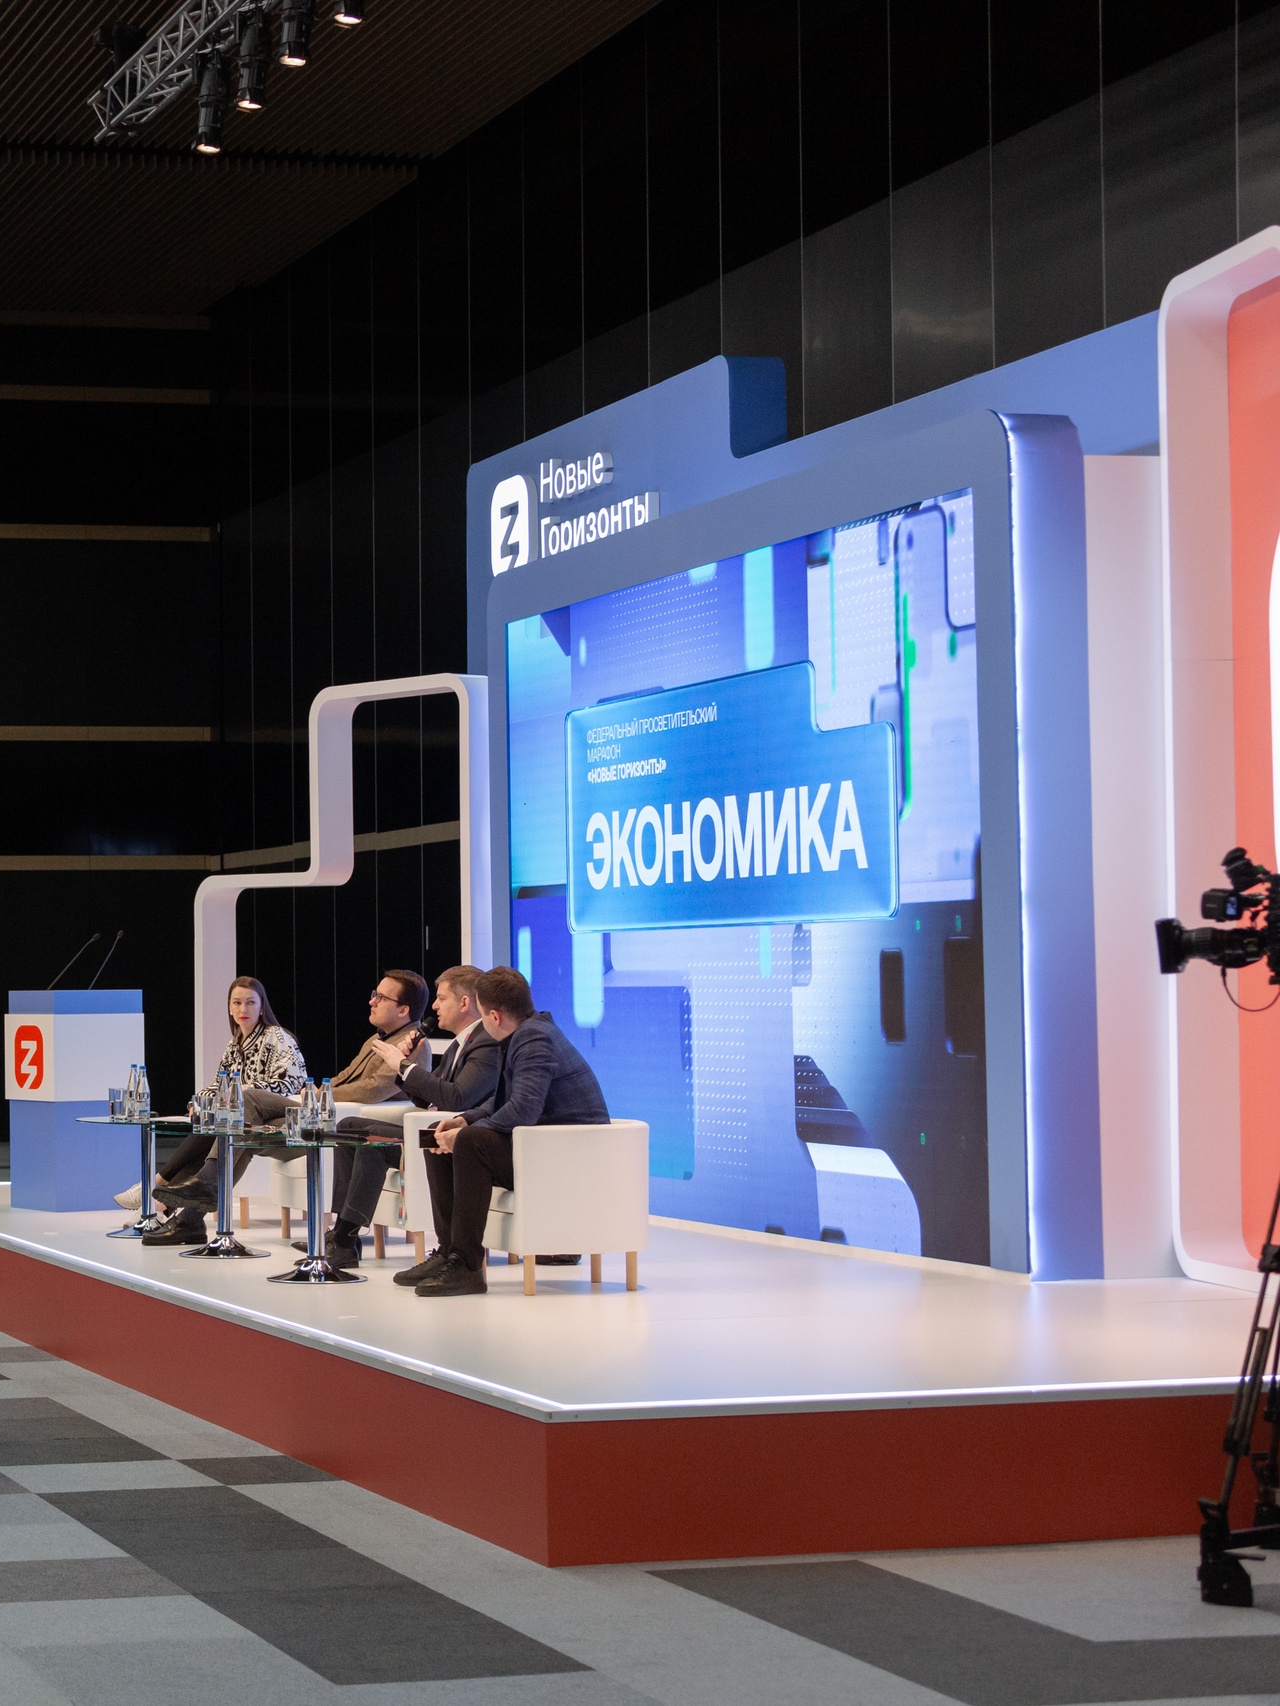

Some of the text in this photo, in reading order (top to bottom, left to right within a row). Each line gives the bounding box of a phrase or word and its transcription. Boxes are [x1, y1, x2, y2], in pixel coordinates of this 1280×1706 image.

[540, 452, 604, 503] Новые
[540, 491, 649, 559] Горизонты
[586, 702, 717, 744] ФЕДЕРАЛЬНЫЙ ПРОСВЕТИТЕЛЬСКИЙ
[587, 743, 621, 763] МАРАФОН
[587, 757, 667, 784] «НОВЫЕ ГОРИЗОНТЫ»
[585, 780, 869, 890] ЭКОНОМИКА
